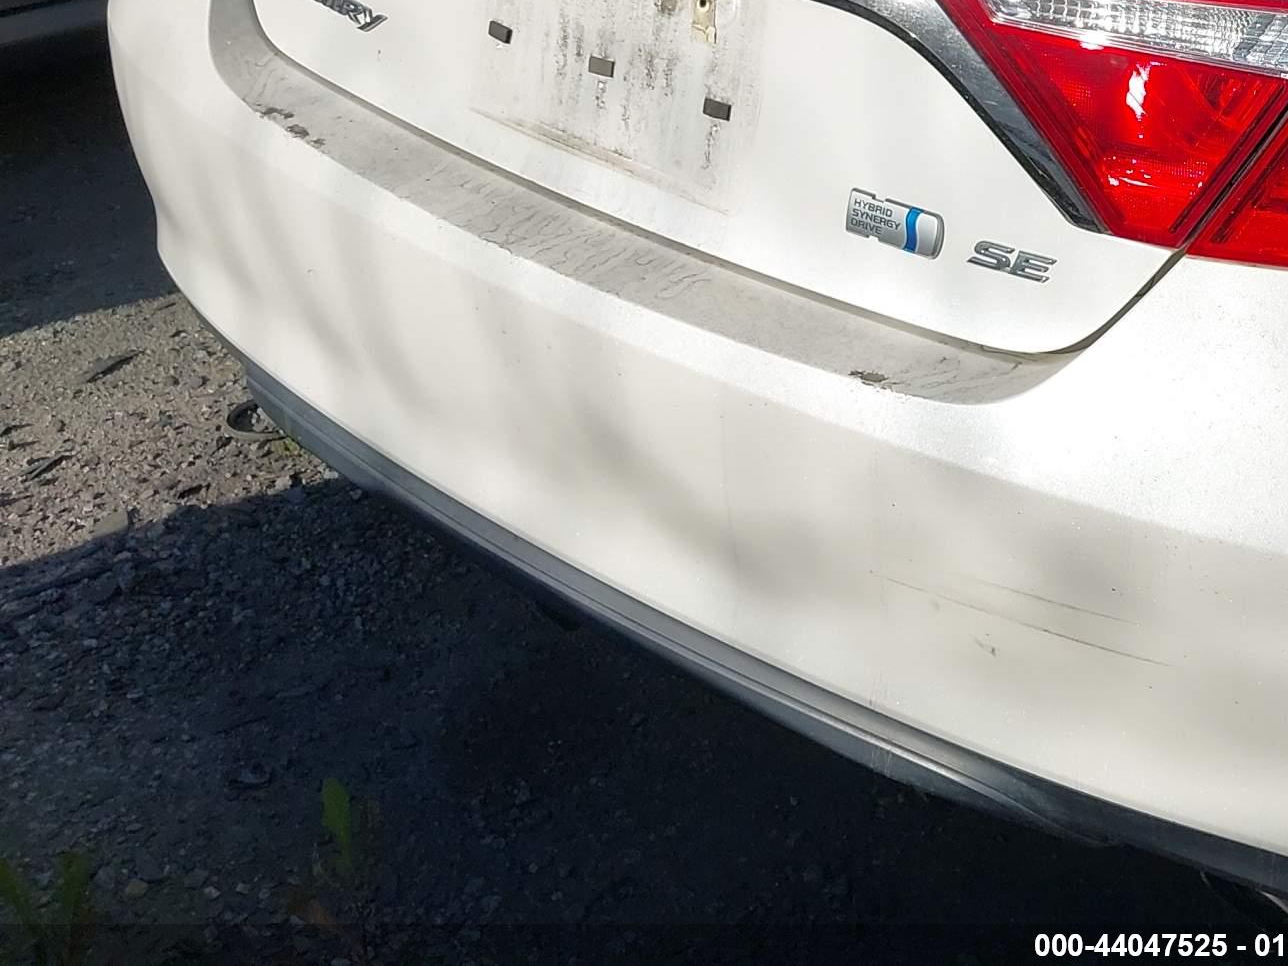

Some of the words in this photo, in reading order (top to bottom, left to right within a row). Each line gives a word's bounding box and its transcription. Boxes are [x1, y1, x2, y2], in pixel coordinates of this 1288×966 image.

[854, 198, 893, 218] HYBRID
[850, 218, 882, 235] DRIVE
[852, 208, 901, 231] SYNERGY
[966, 240, 1058, 284] SE
